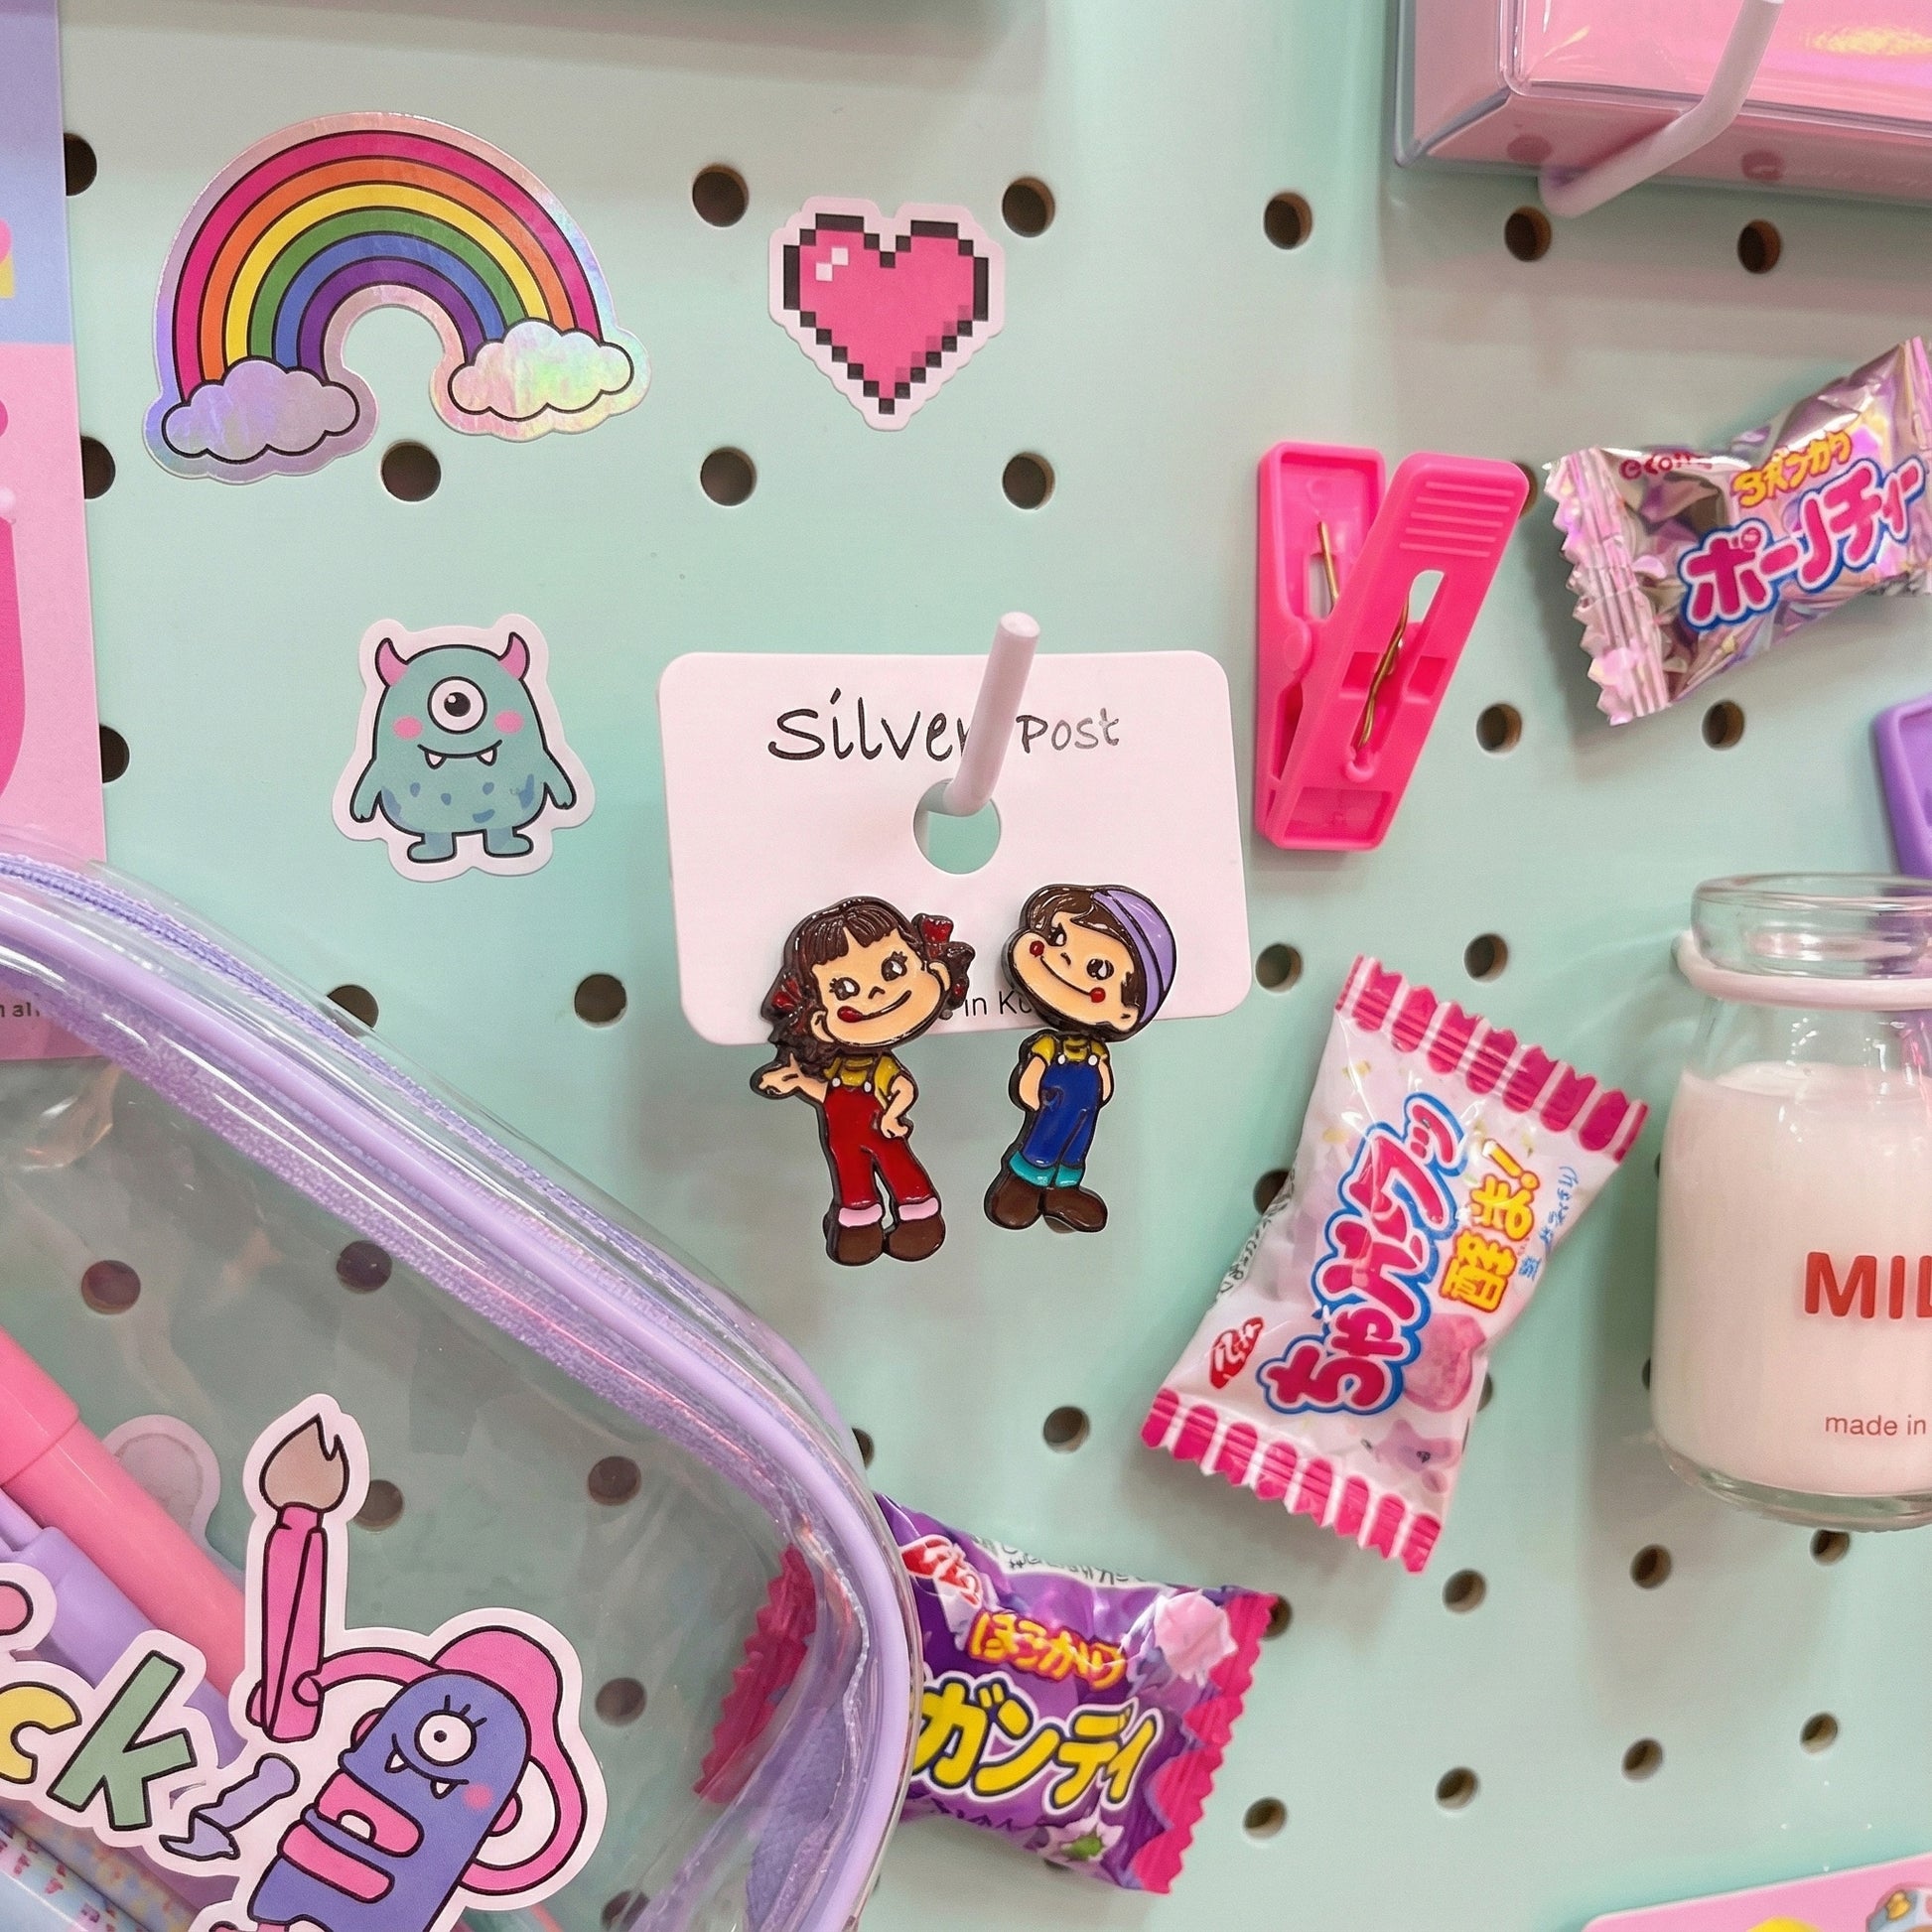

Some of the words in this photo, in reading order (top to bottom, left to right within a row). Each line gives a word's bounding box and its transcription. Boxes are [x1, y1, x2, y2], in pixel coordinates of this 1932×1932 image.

[964, 996, 988, 1018] in
[1825, 1415, 1898, 1437] made
[1906, 1414, 1927, 1436] in
